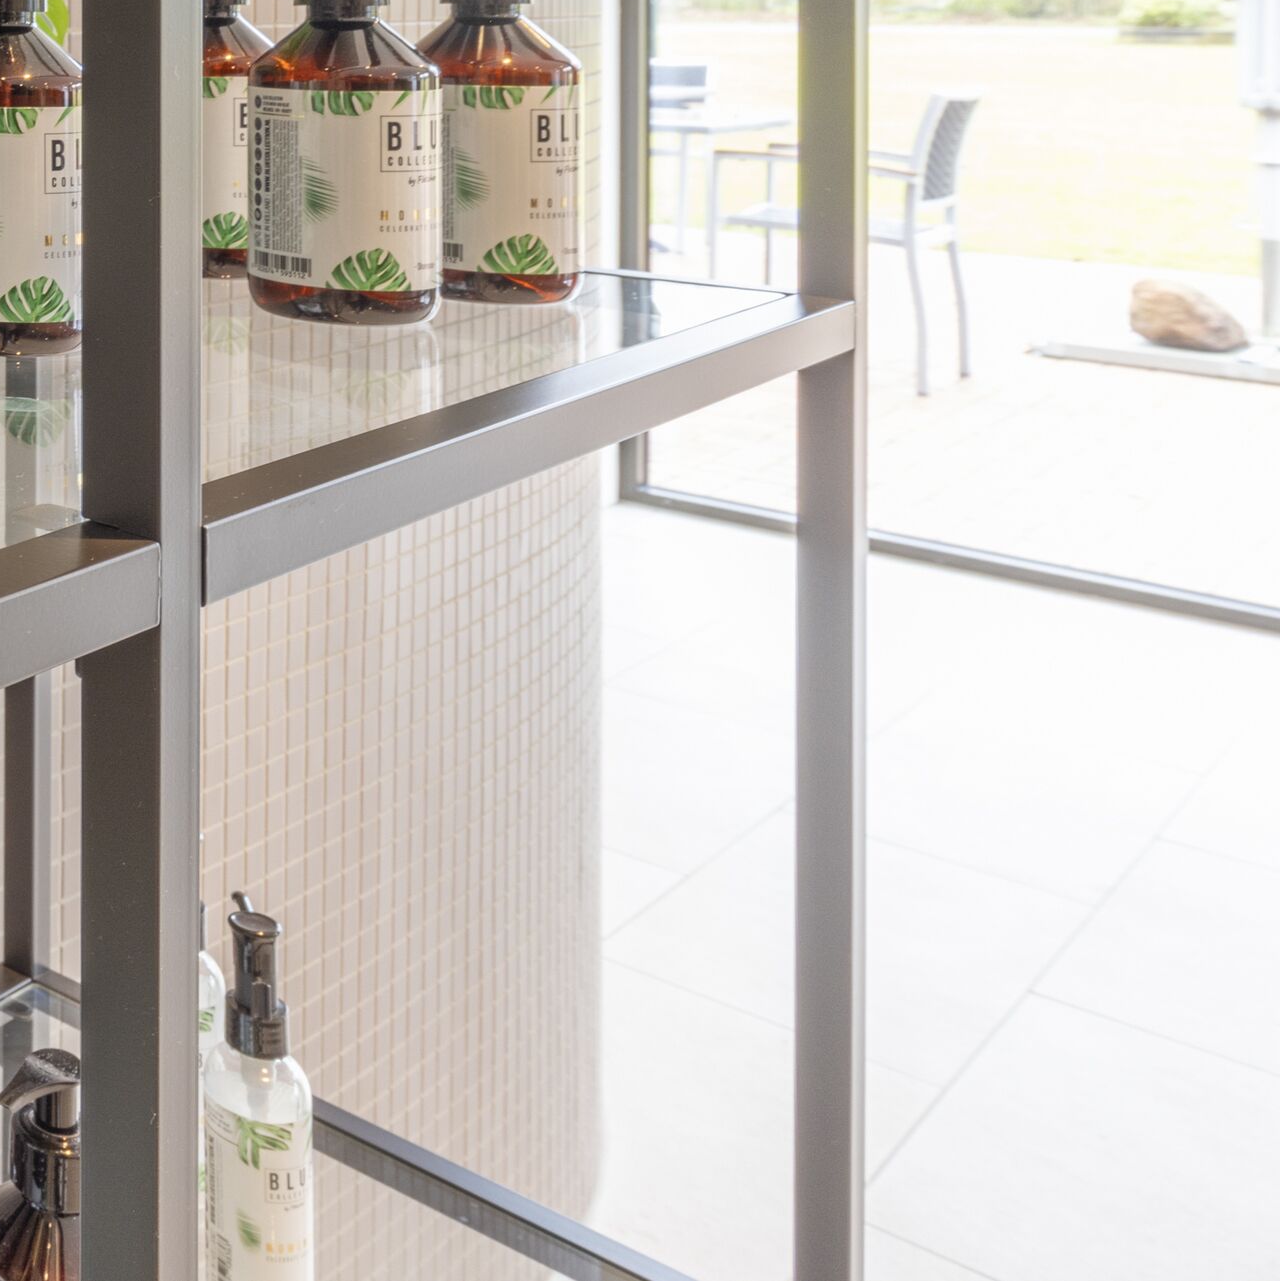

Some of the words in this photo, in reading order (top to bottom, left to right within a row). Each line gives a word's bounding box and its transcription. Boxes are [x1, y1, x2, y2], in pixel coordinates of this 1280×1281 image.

[387, 121, 437, 152] BLU
[51, 138, 82, 172] BL
[269, 1167, 306, 1191] BLU
